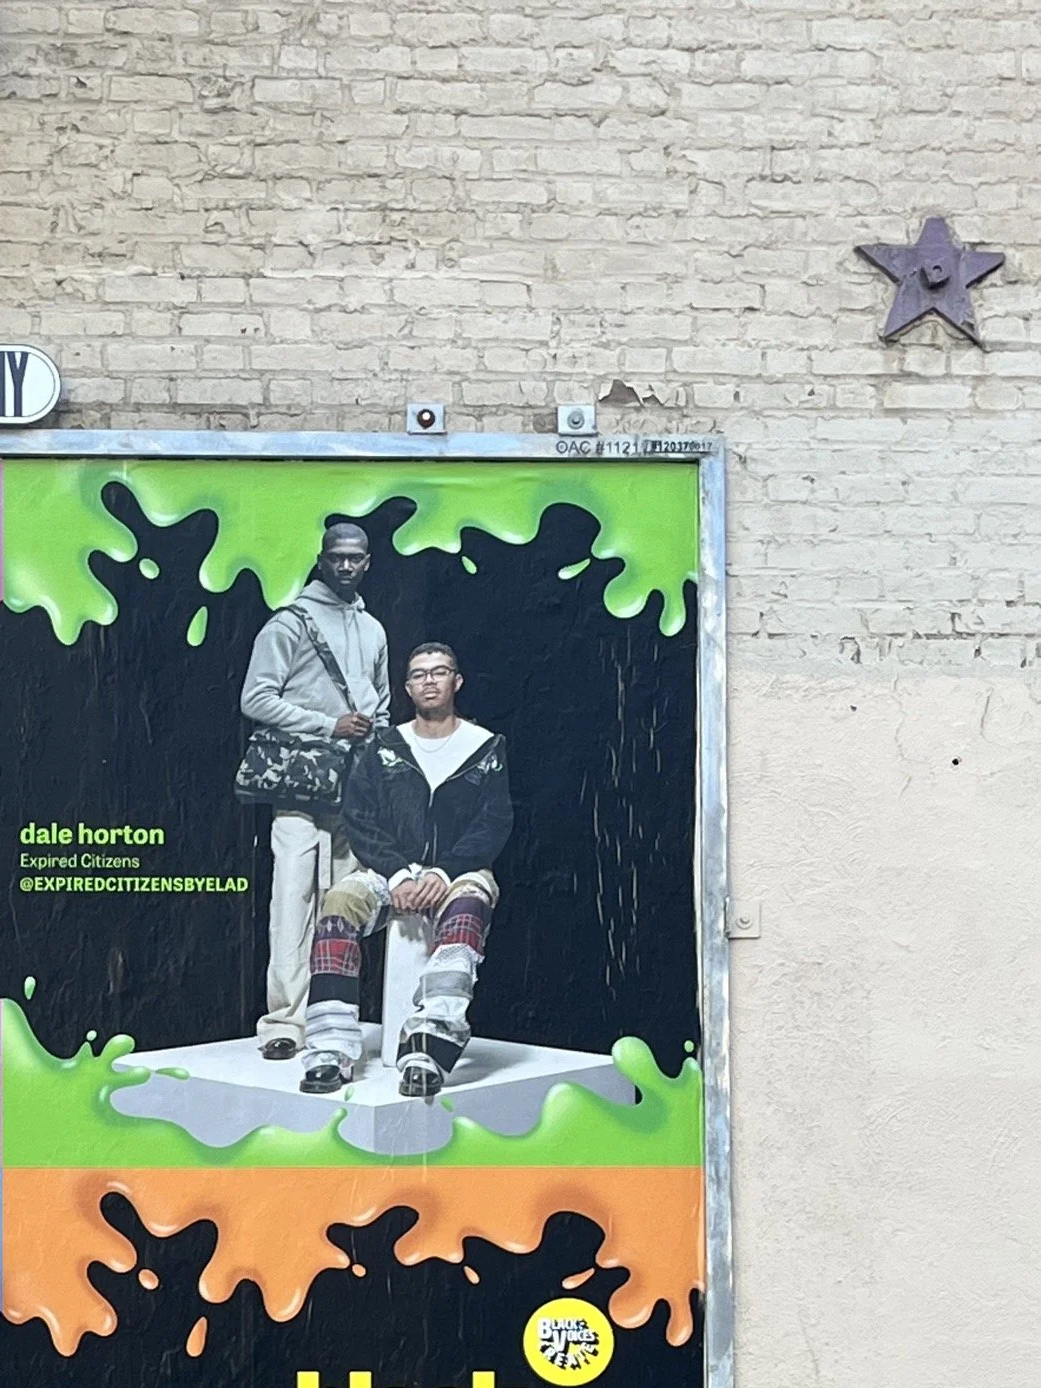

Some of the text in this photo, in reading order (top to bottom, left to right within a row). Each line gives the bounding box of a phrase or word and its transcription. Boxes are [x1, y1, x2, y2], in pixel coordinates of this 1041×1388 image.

[556, 440, 591, 454] OAC
[20, 822, 165, 845] dale horton
[20, 853, 140, 870] Expired Citizens
[20, 876, 249, 893] @EXPIREDCITIZENSBYELAD
